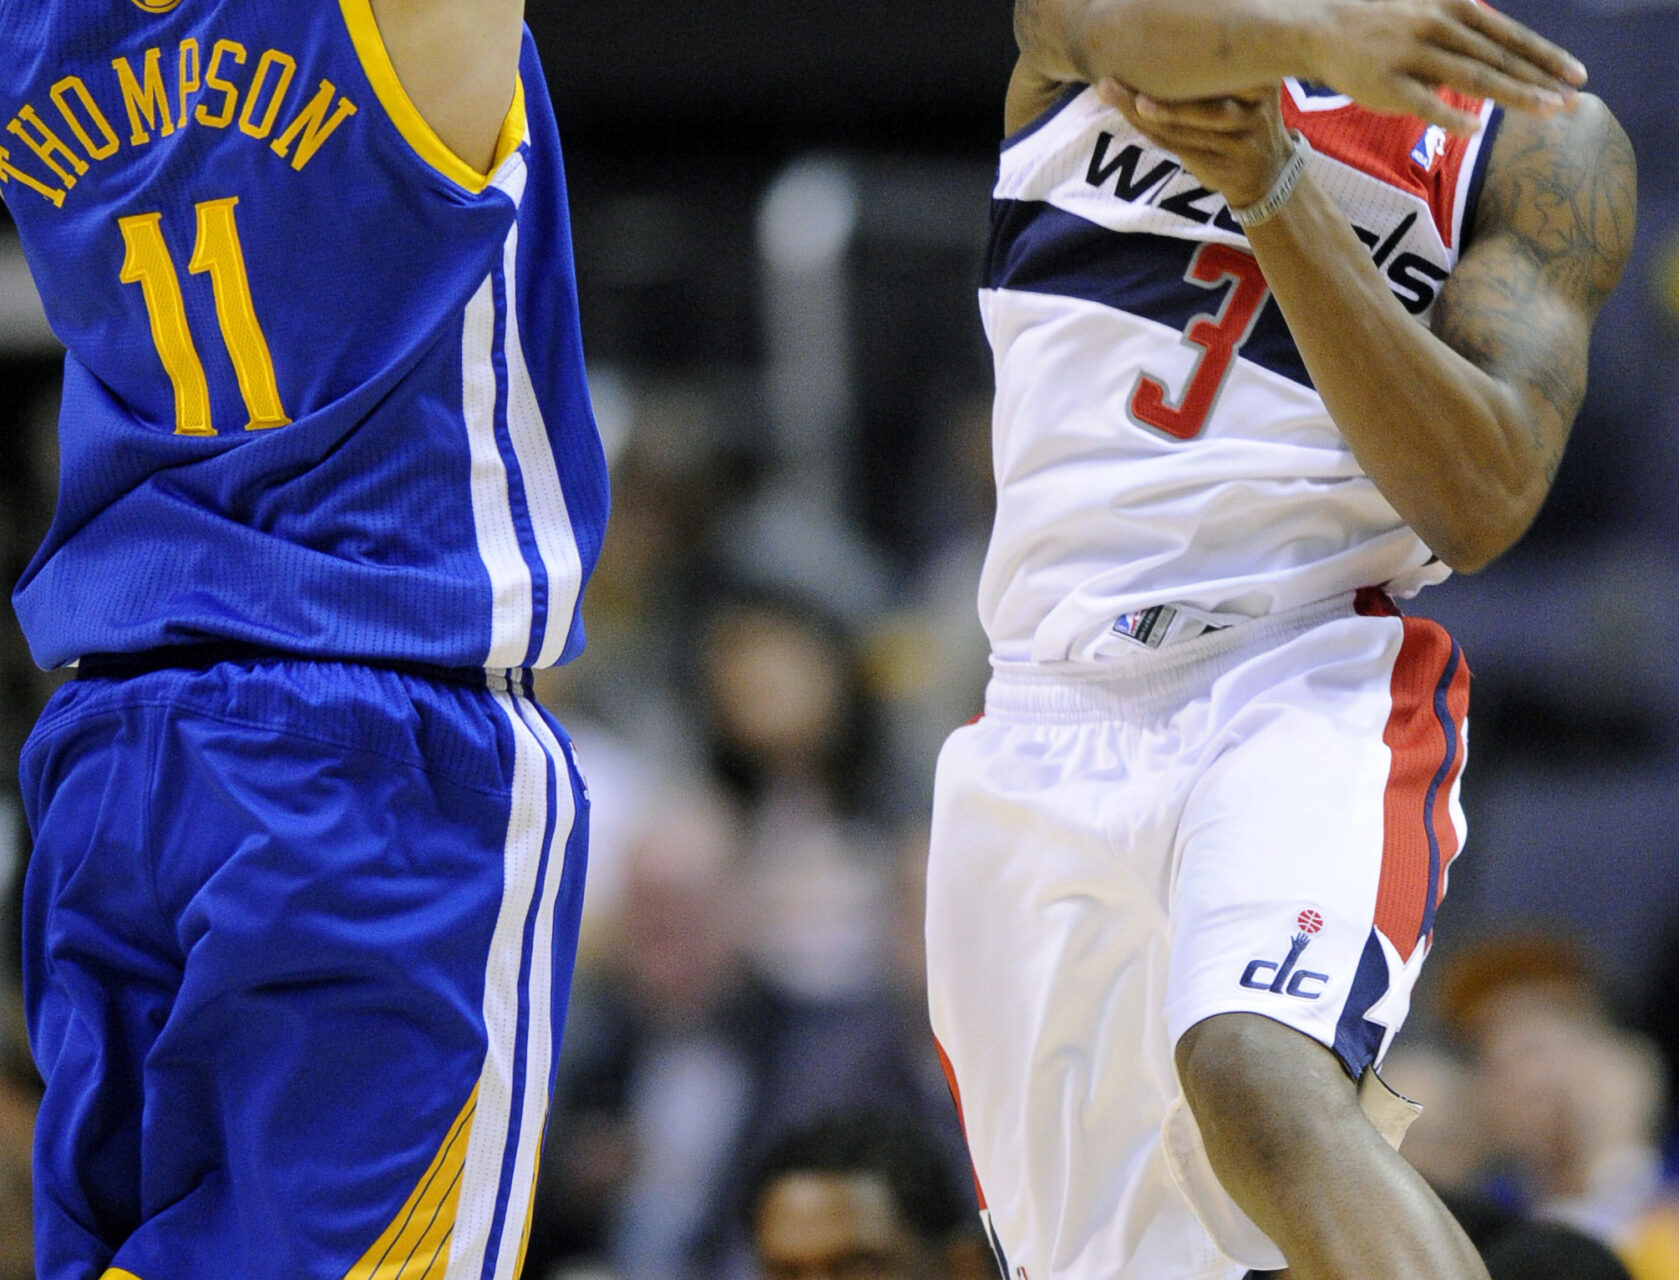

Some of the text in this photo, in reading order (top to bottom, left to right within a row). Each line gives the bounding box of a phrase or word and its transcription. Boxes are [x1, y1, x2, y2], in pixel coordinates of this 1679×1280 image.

[0, 38, 357, 207] THOMPSON
[118, 197, 292, 436] 11
[1126, 242, 1270, 442] 3
